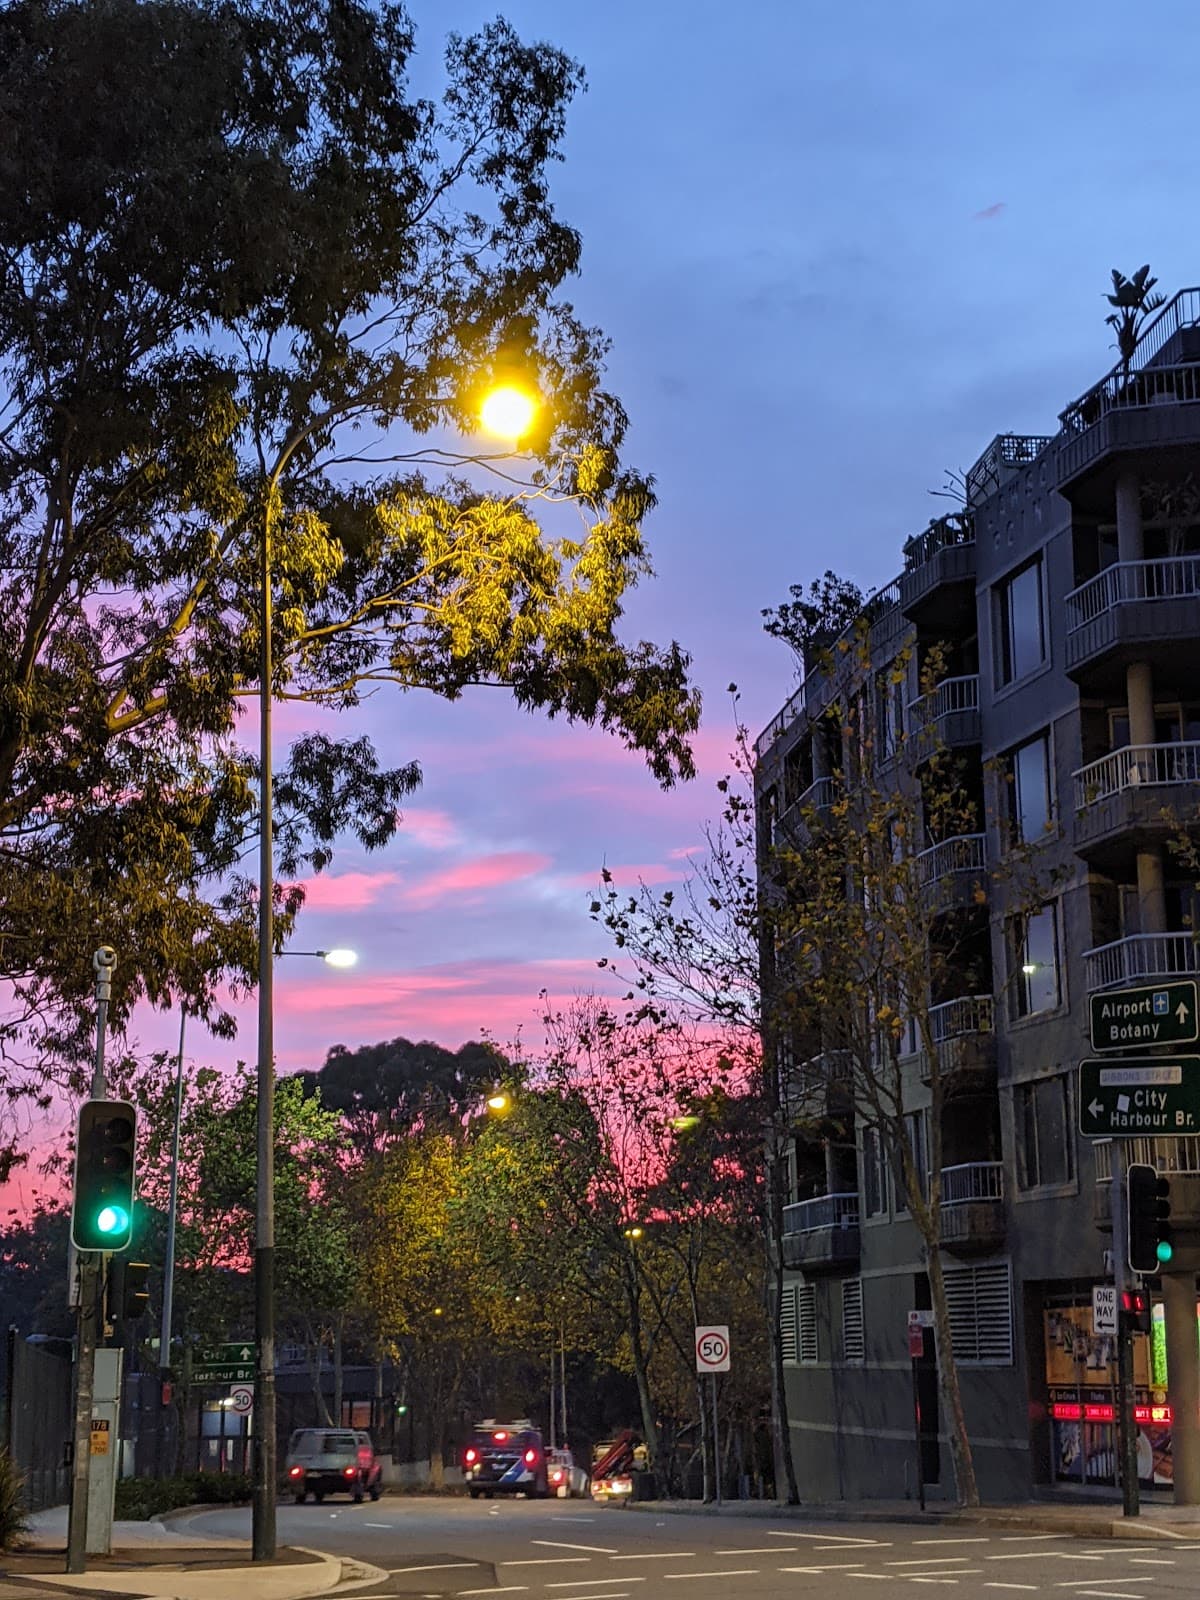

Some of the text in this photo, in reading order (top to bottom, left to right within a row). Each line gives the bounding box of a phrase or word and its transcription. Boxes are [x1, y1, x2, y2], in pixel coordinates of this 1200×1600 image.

[1101, 998, 1151, 1019] Airport
[1110, 1023, 1160, 1040] Botany
[1134, 1090, 1168, 1110] City
[1110, 1110, 1195, 1127] Harbour Br.
[1096, 1290, 1114, 1303] ONE
[1095, 1305, 1114, 1318] WAY
[702, 1341, 723, 1357] 50
[237, 1369, 253, 1379] Br.
[235, 1395, 249, 1406] 50
